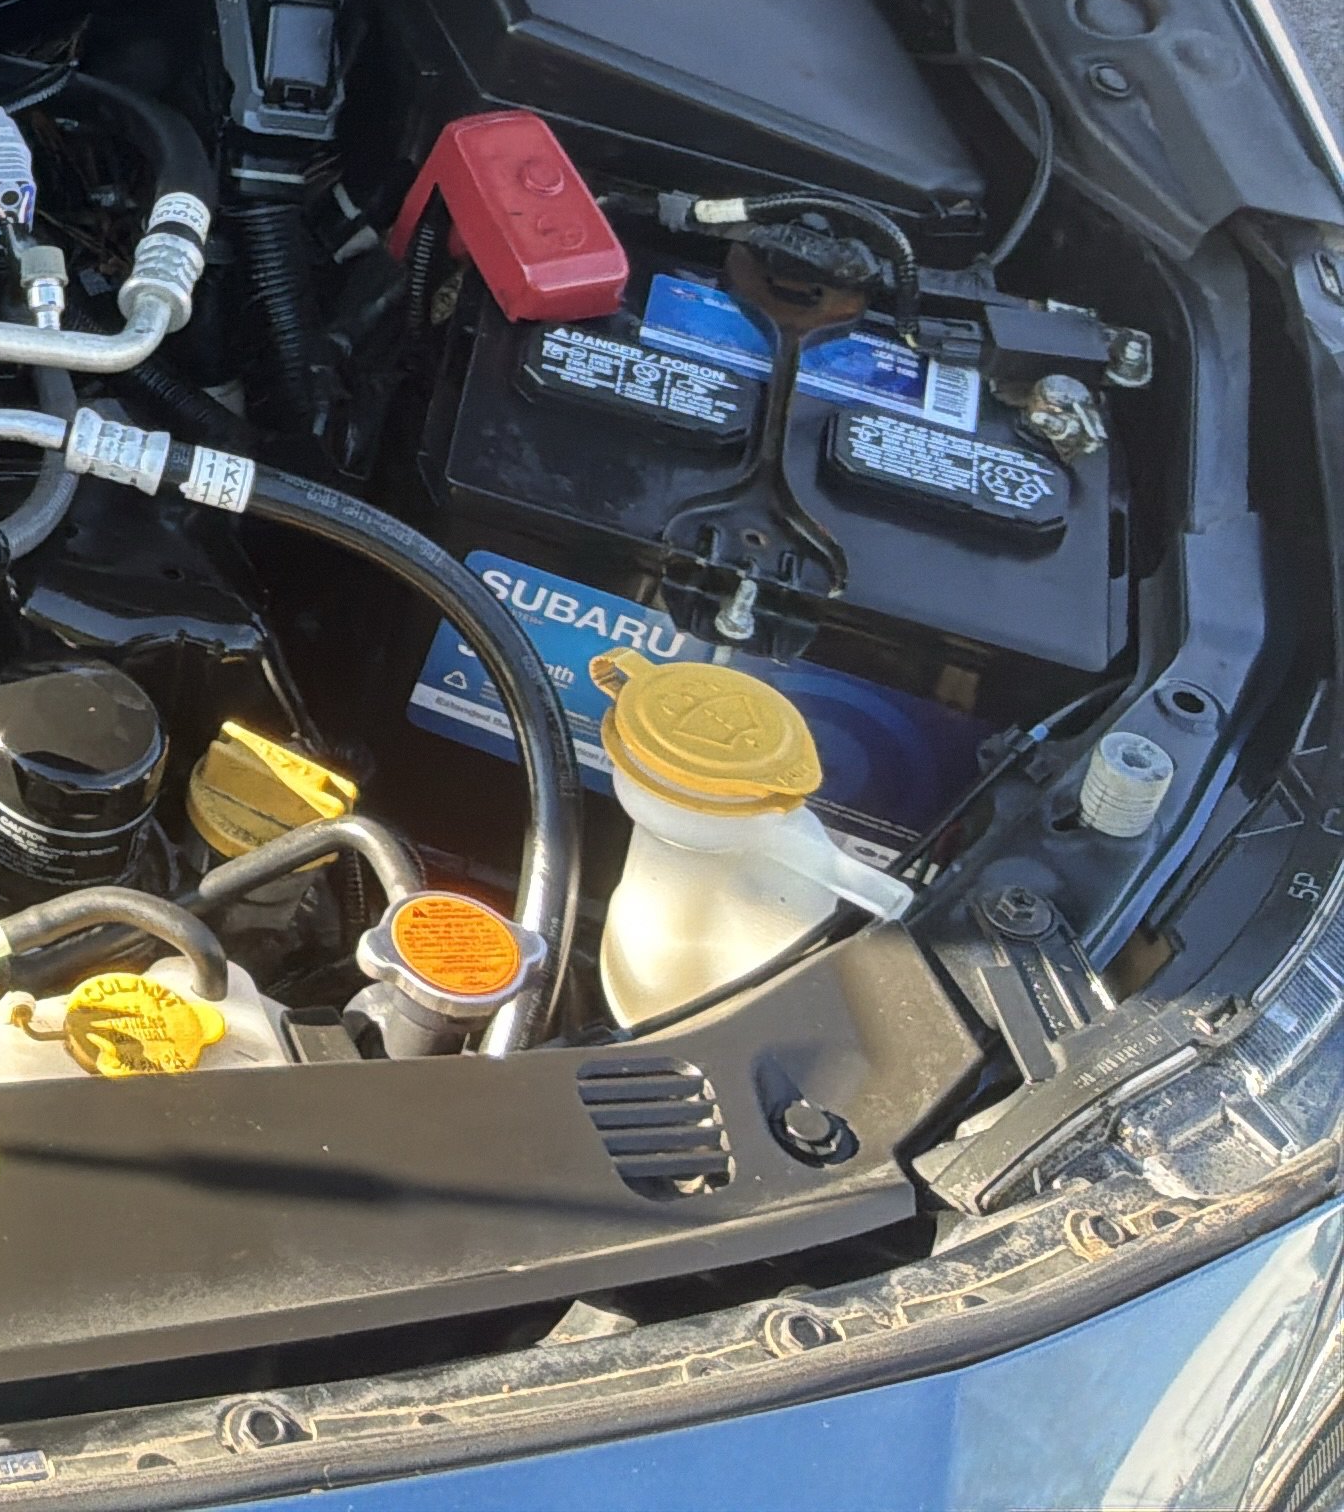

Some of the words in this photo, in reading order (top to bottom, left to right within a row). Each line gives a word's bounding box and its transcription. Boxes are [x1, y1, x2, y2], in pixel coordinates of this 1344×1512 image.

[571, 332, 644, 360] DANGER
[659, 355, 728, 383] POISON
[481, 570, 686, 659] SUBARU
[0, 815, 48, 844] CAUTION
